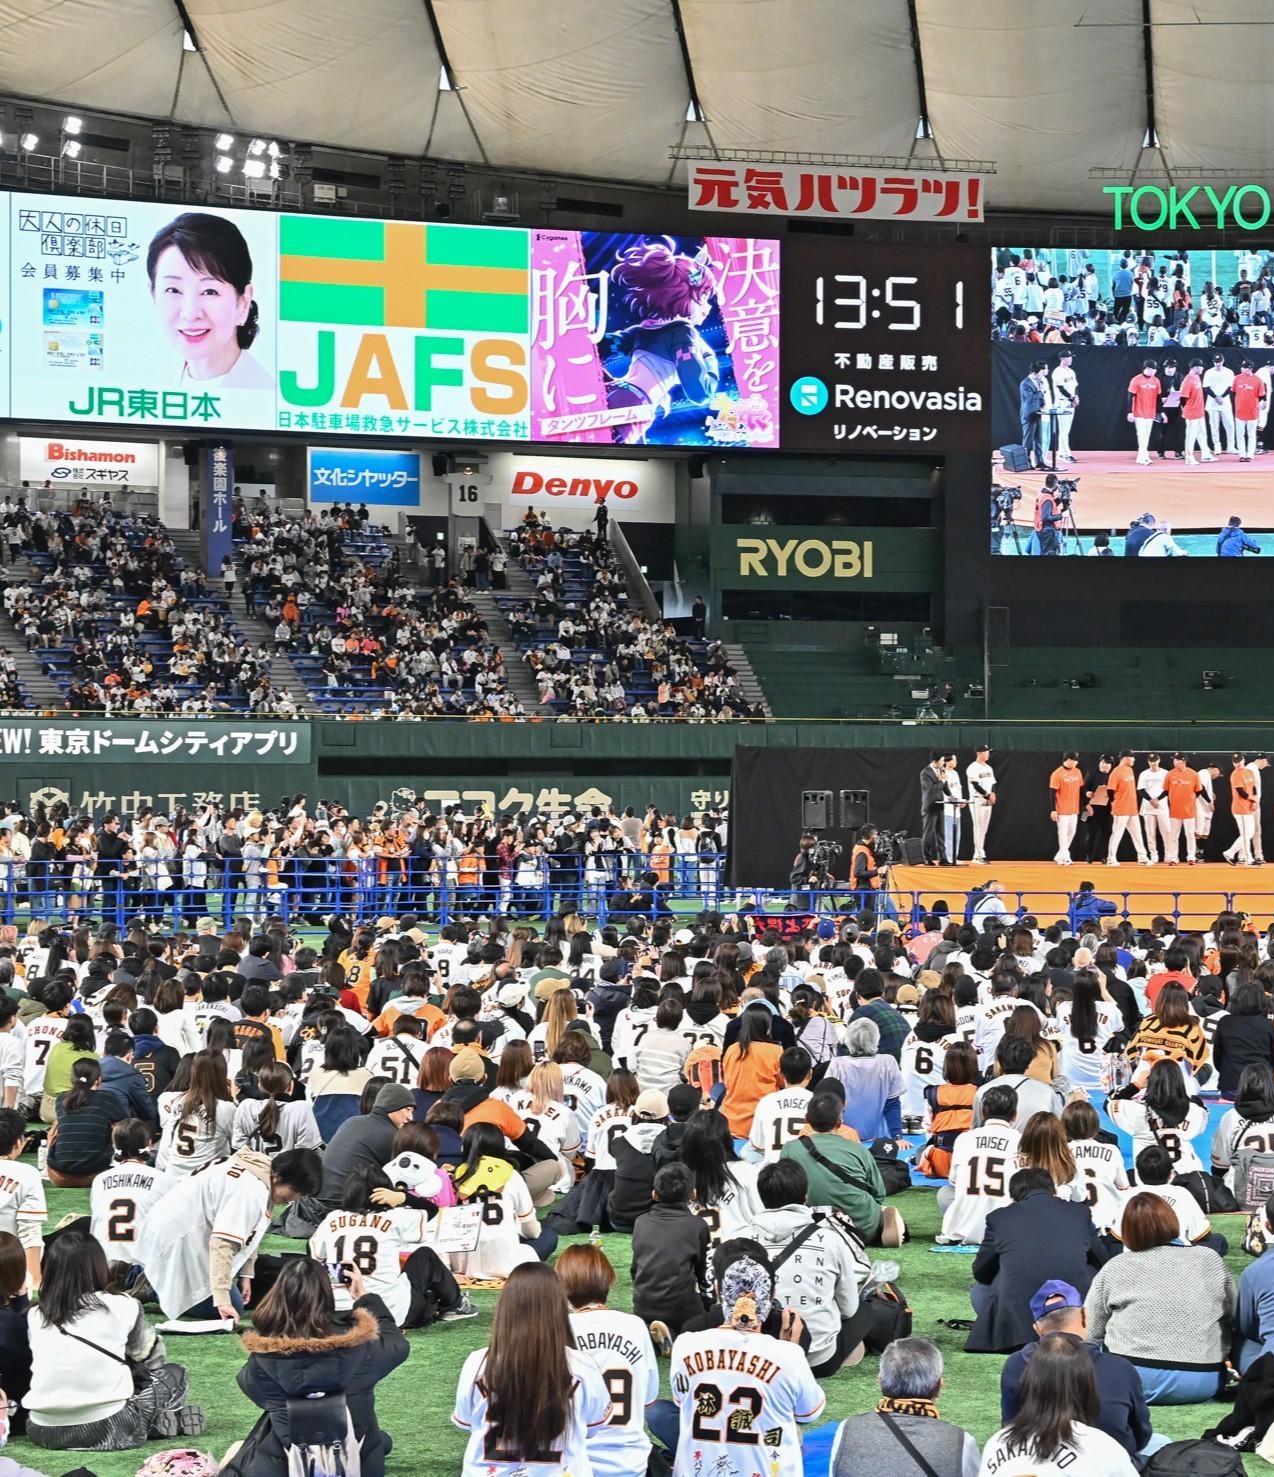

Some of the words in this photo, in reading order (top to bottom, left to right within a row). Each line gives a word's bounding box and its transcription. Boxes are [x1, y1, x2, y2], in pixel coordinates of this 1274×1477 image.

[1103, 185, 1271, 230] TOKYO
[21, 262, 126, 284] 会員募集中
[531, 261, 609, 412] 胸に
[280, 331, 527, 415] JAFS
[834, 353, 938, 371] 不動産販売
[69, 387, 221, 422] JR東日本
[834, 385, 982, 412] Renovasia
[278, 410, 529, 438] 日本駐車場救急サービス株式会社
[834, 425, 938, 441] リノベーション
[47, 443, 135, 465] Bishamon
[85, 467, 130, 482] スギヤス
[511, 472, 639, 504] Denyo
[457, 484, 478, 502] 16
[736, 538, 873, 578] RYOBI
[39, 728, 298, 756] 東京ドームシティアプリ
[27, 964, 40, 979] 8
[349, 965, 362, 984] 8
[438, 959, 450, 977] 8
[632, 1024, 648, 1046] 7
[34, 1039, 51, 1065] 7
[915, 1047, 934, 1074] 6
[975, 1136, 1009, 1152] TAISEI
[102, 1173, 155, 1192] YOSHIKAWA
[967, 1156, 1005, 1197] 15
[109, 1199, 136, 1241] 2
[329, 1210, 393, 1233] SUGANO
[334, 1235, 379, 1275] 18
[683, 1349, 782, 1384] KOBAYASHI
[692, 1382, 763, 1446] 22
